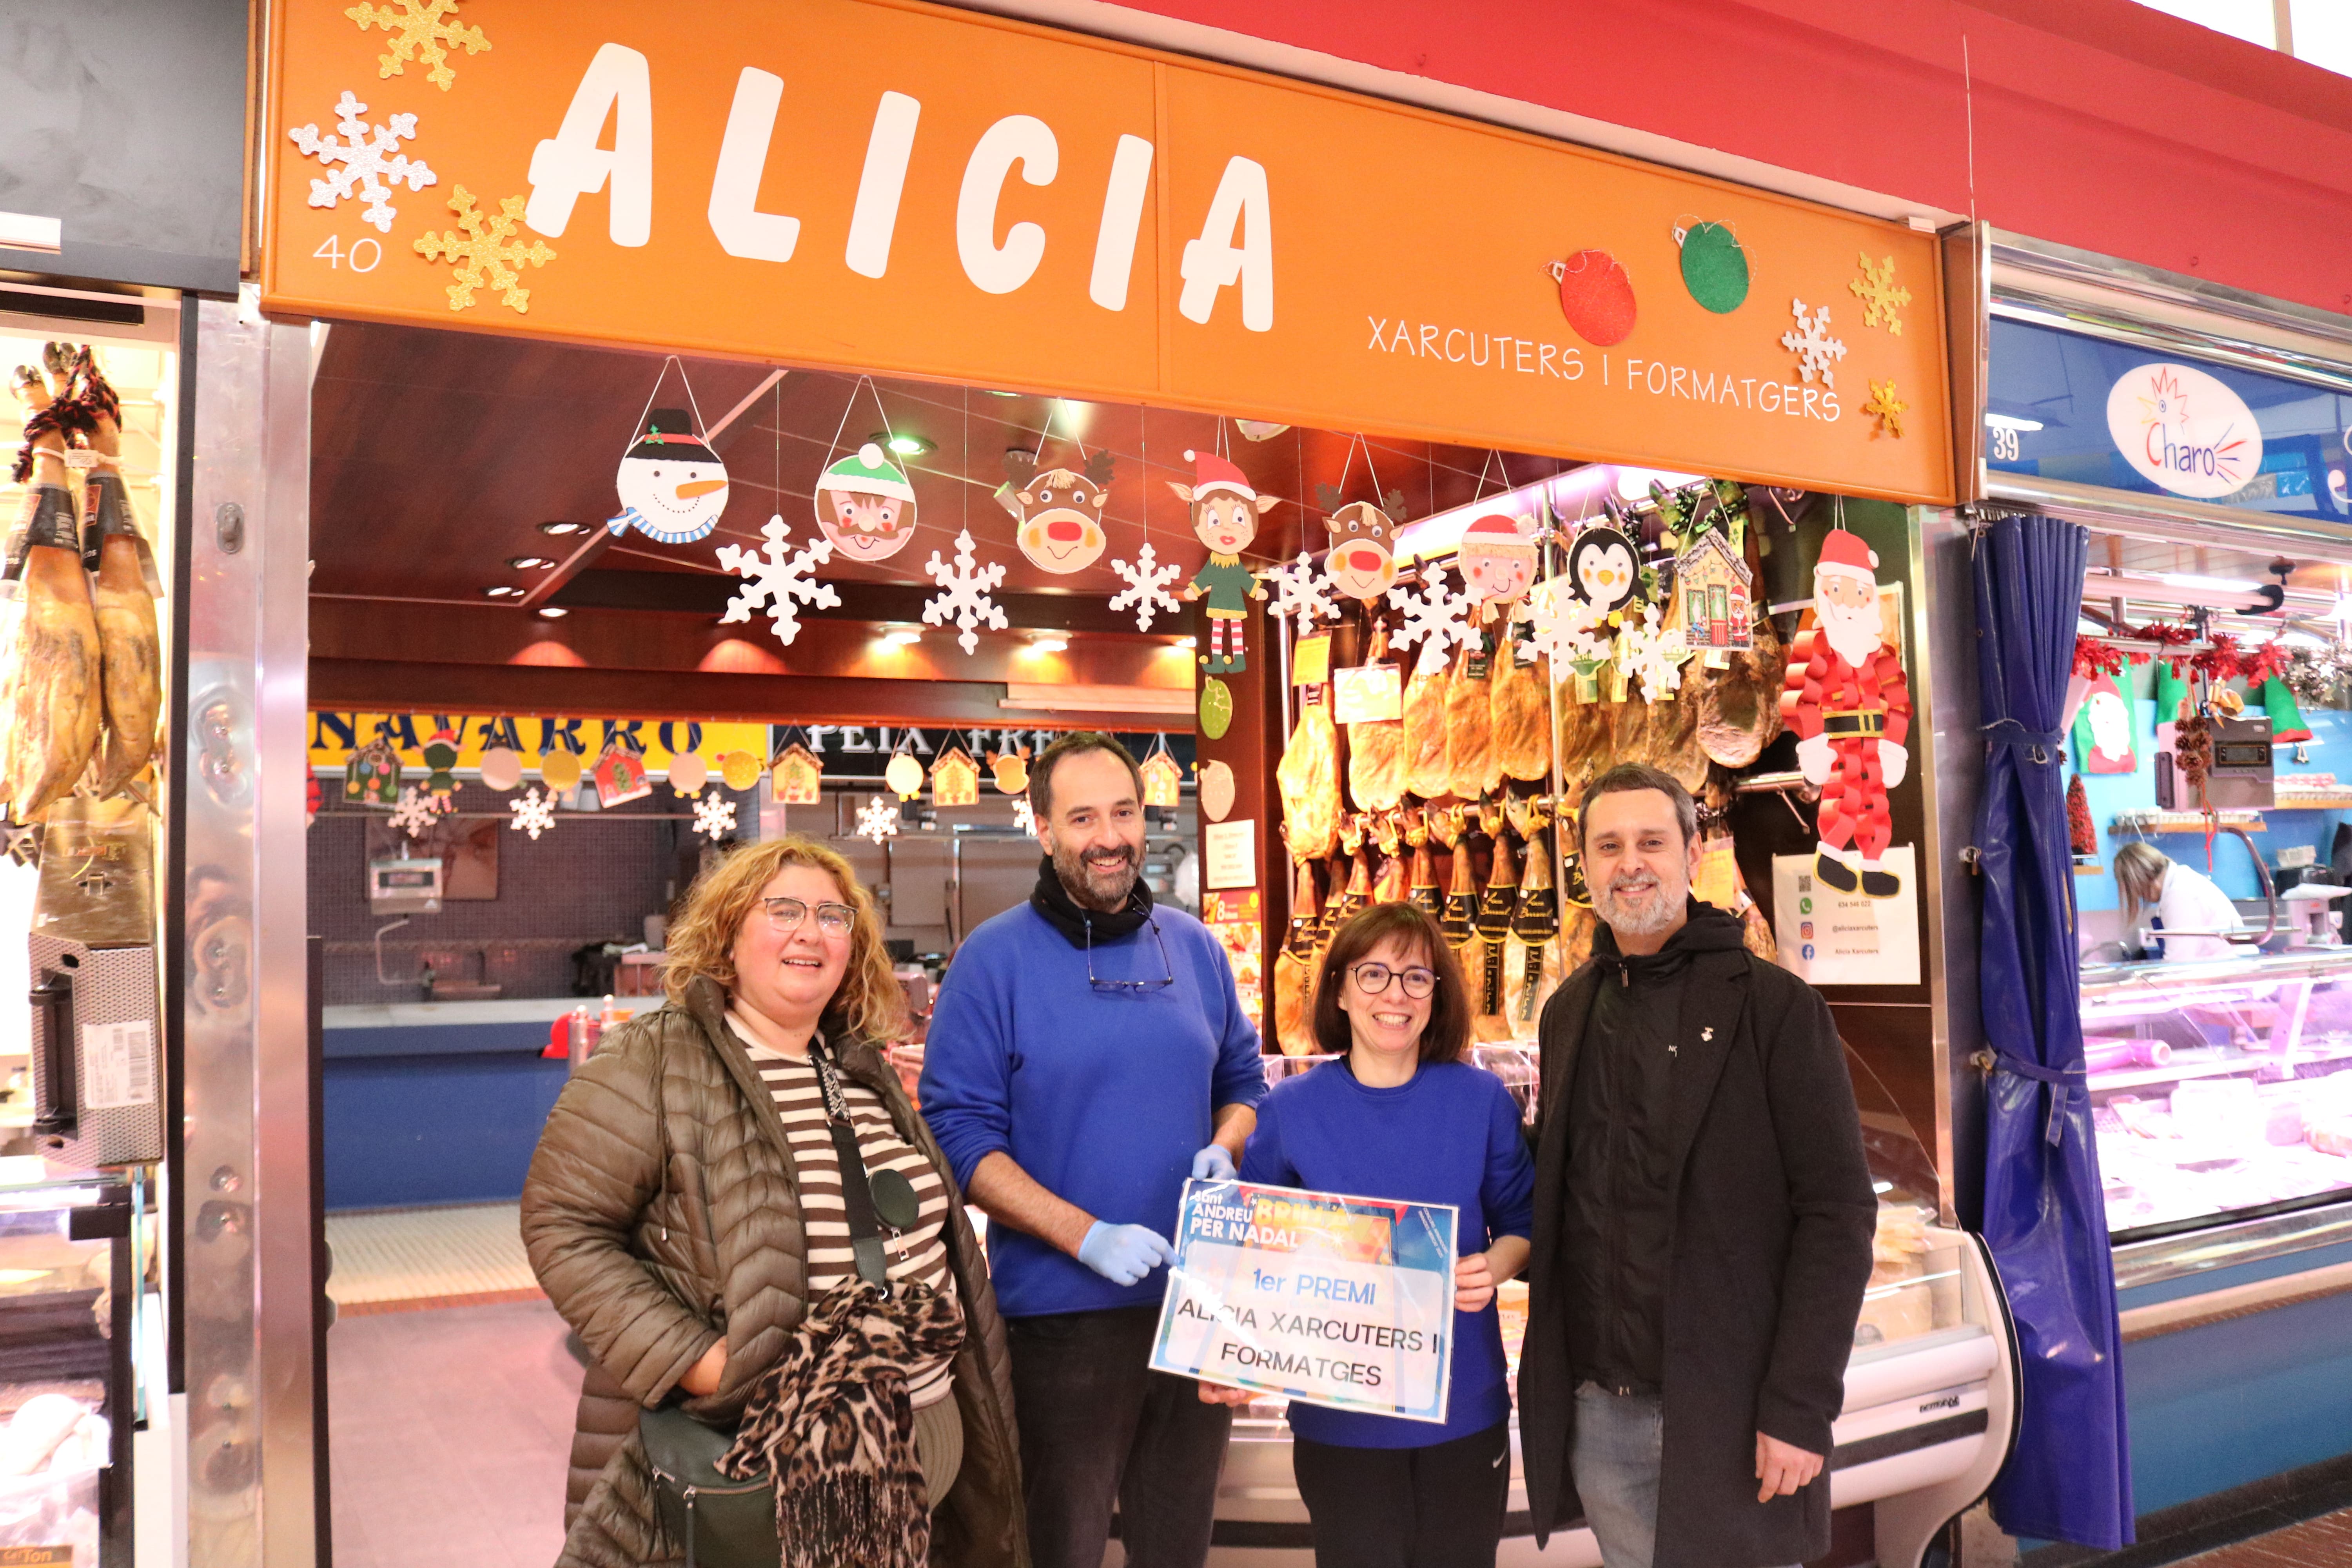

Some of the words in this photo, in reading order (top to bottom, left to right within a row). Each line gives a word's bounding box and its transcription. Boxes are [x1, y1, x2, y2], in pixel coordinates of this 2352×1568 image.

[524, 42, 1274, 332] ALICIA
[312, 234, 381, 272] 40
[1368, 316, 1584, 381] XARCUTERS
[1602, 354, 1608, 386] I
[1628, 359, 1840, 421] FORMATGERS
[1993, 427, 2019, 461] 39
[2147, 422, 2215, 475] Charo
[311, 712, 703, 755] NAVARRO
[806, 724, 933, 755] PEIX
[1192, 1204, 1253, 1223] ANDREU
[1195, 1191, 1223, 1205] Sant
[1190, 1217, 1224, 1238] PER
[1229, 1222, 1298, 1248] NADAL
[1254, 1269, 1286, 1292] 1er
[1296, 1274, 1375, 1305] PREMI
[1270, 1312, 1422, 1352] XARCUTERS
[1432, 1334, 1437, 1354] I
[1221, 1343, 1381, 1385] FORMATGES
